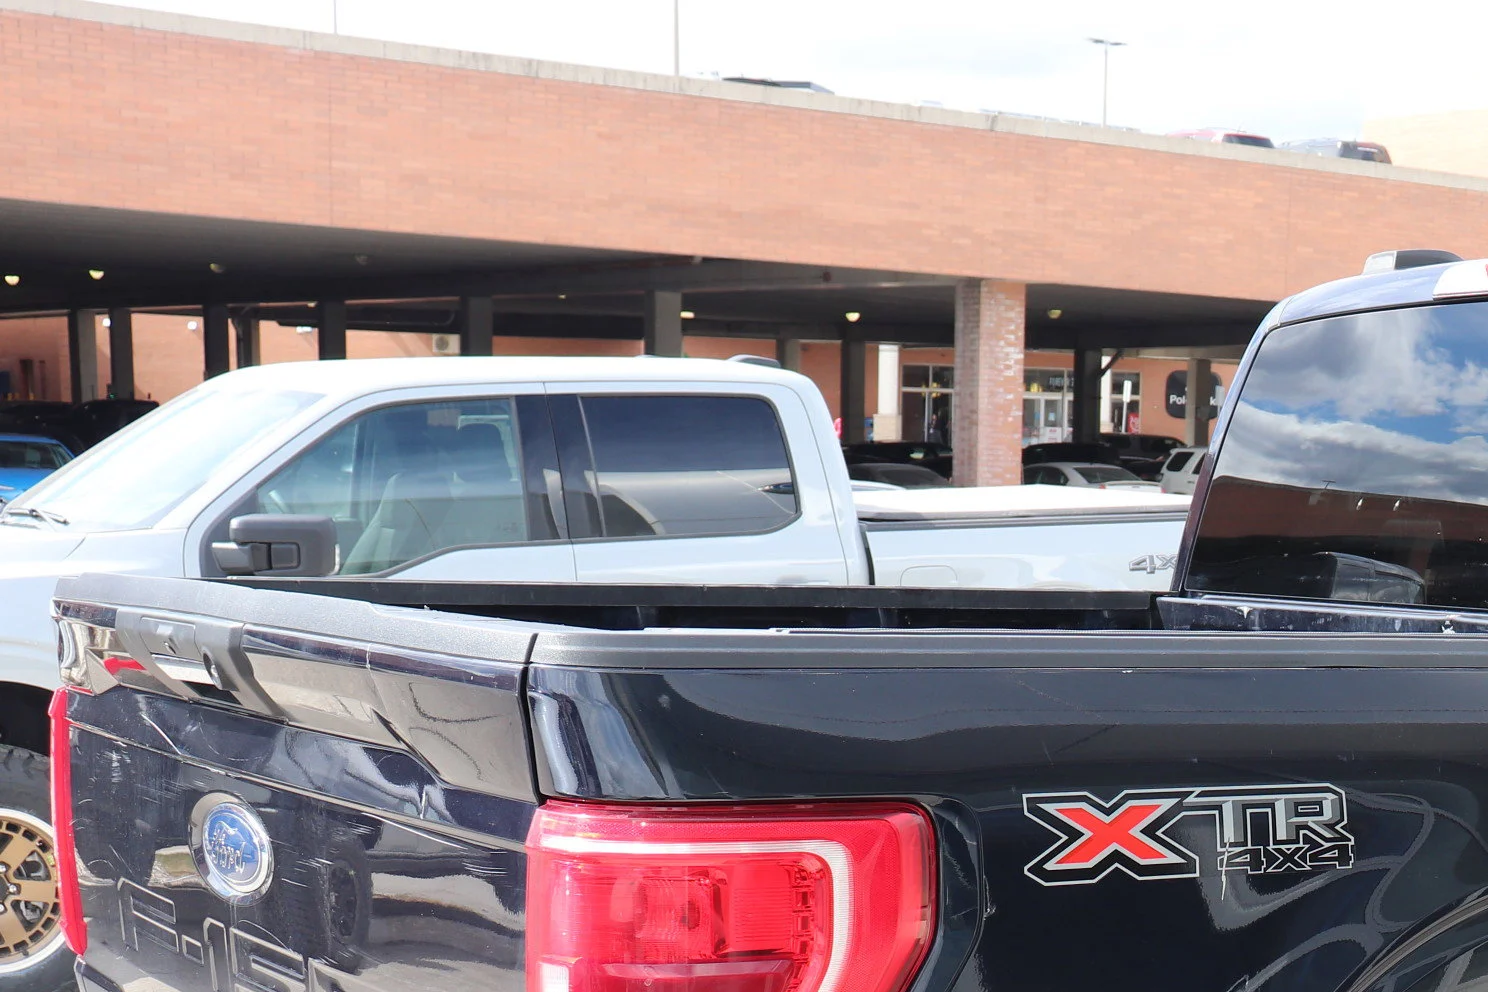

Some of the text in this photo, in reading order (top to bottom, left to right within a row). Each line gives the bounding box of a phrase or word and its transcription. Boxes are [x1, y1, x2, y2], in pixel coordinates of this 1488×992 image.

[1169, 394, 1188, 405] Pol
[1129, 554, 1178, 574] 4X
[210, 820, 246, 874] Ford
